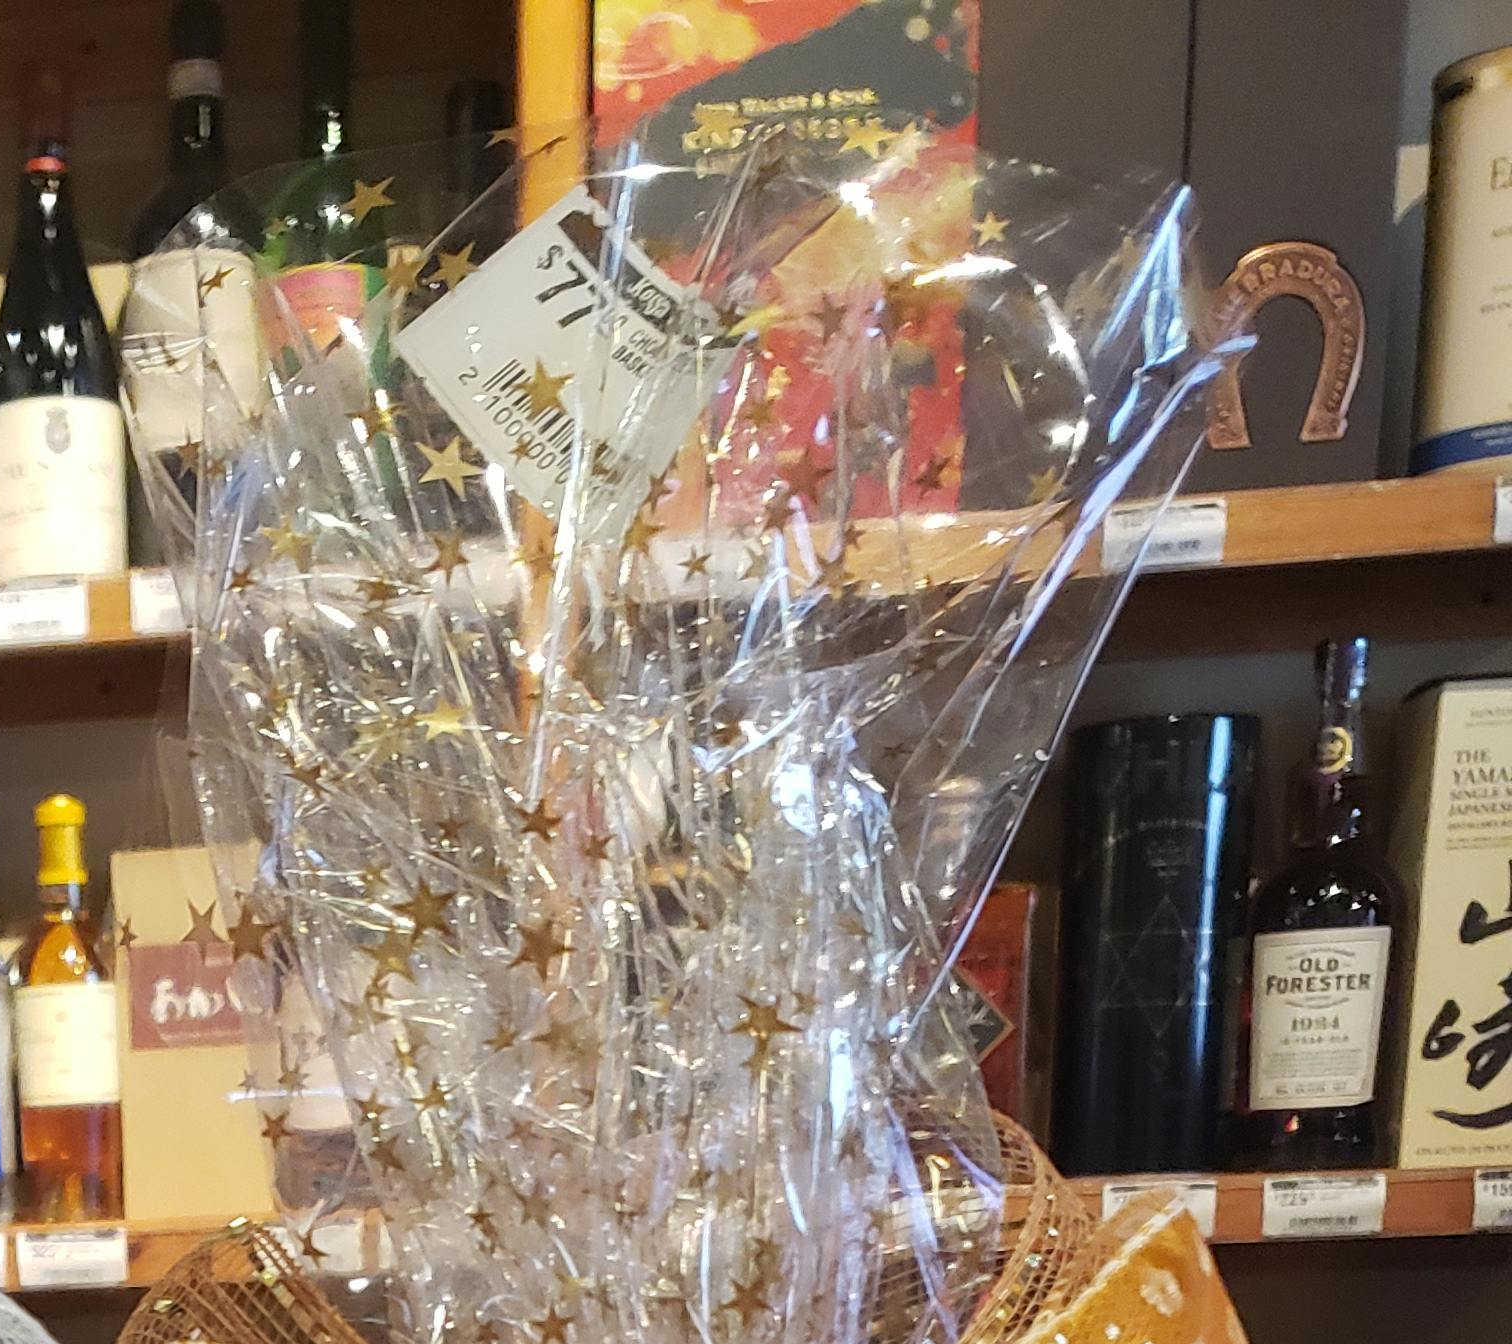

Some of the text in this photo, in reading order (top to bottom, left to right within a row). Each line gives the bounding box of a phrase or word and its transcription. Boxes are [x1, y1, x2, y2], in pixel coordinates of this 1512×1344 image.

[1452, 767, 1512, 786] YAMA
[1298, 957, 1340, 974] OLD
[1265, 973, 1372, 996] FORESTER
